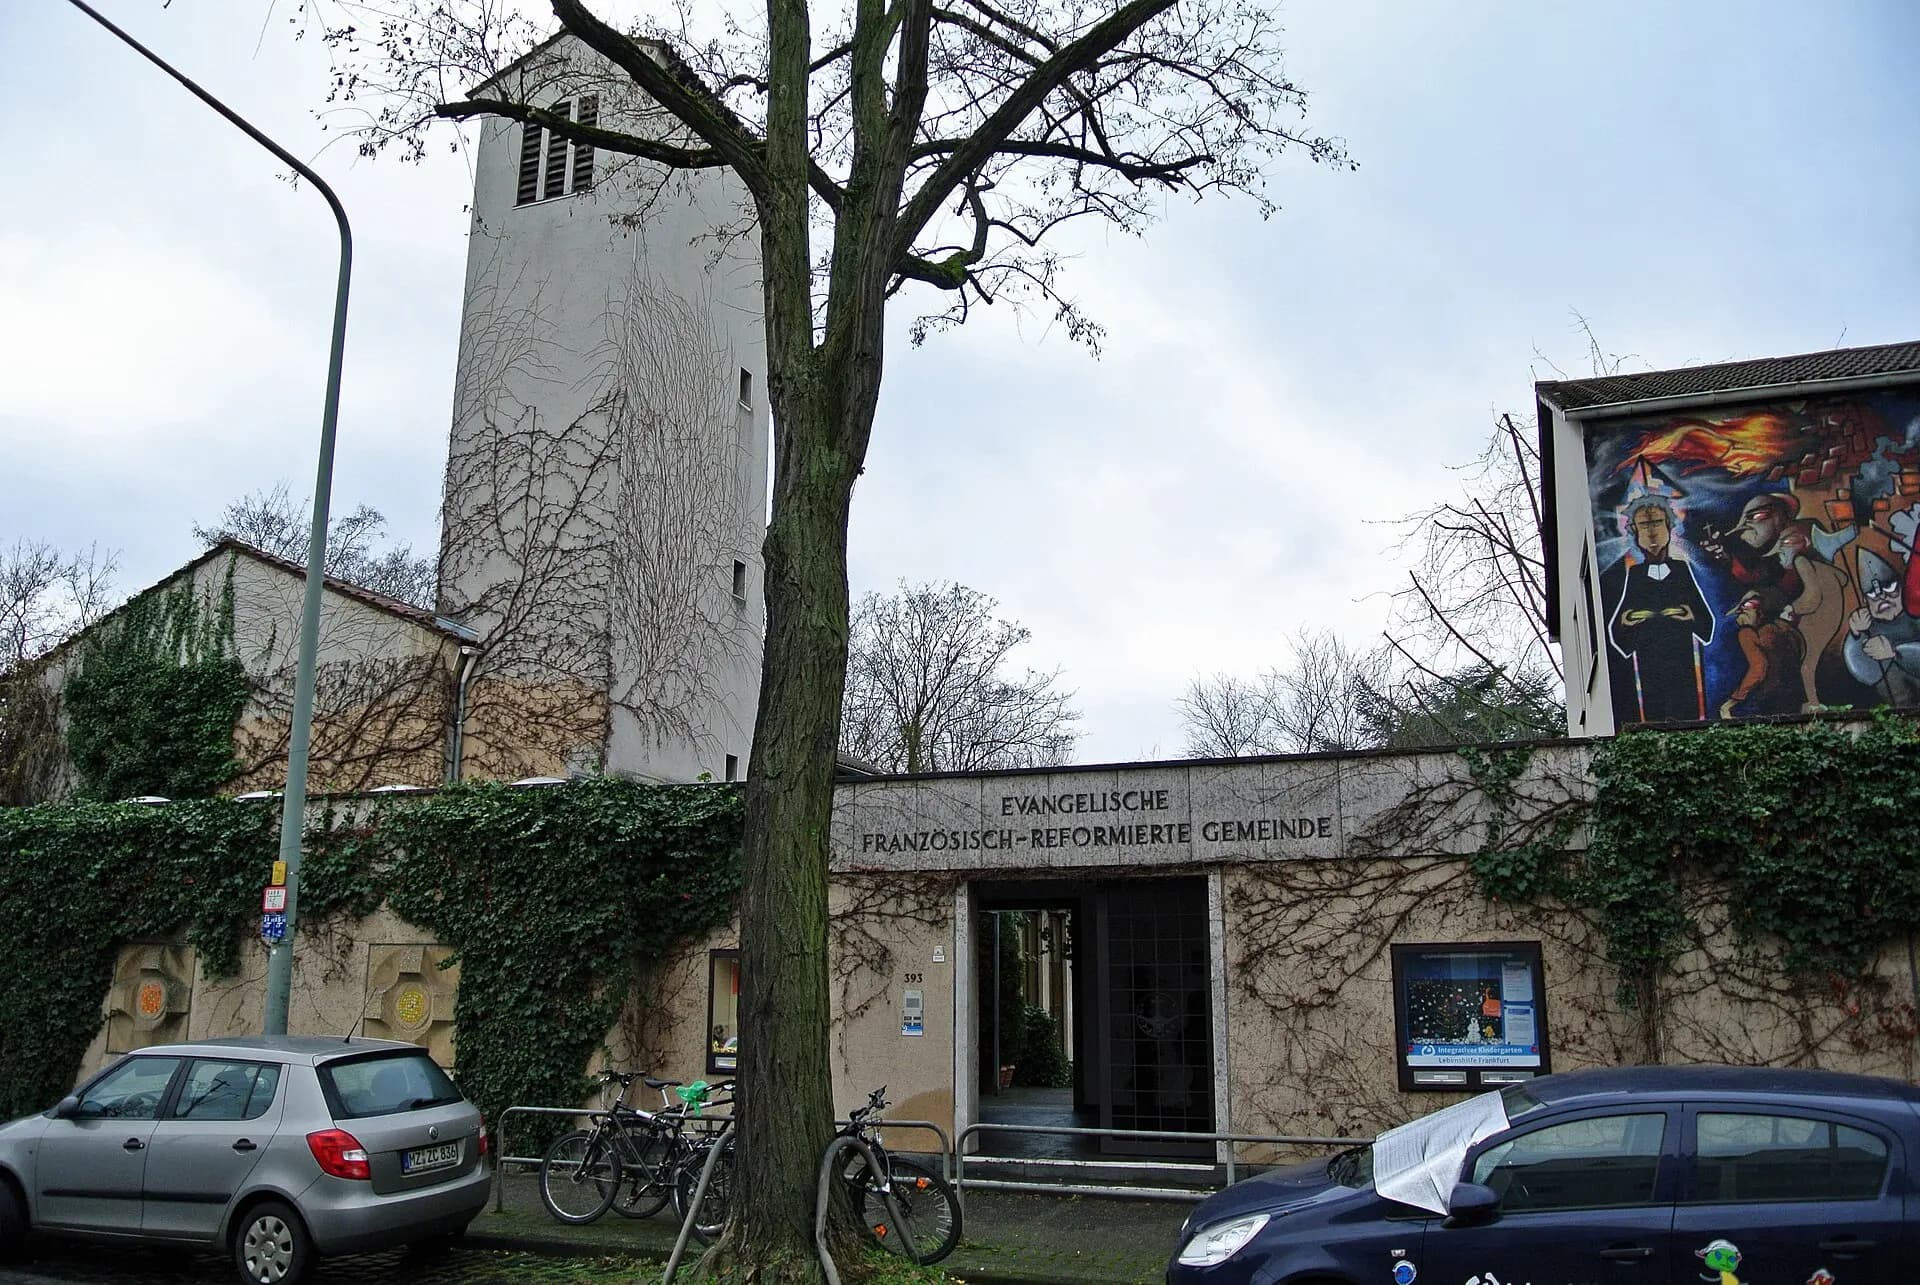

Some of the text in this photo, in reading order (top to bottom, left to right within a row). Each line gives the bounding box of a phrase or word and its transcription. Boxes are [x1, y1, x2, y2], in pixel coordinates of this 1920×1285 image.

[1001, 790, 1169, 817] EVANGELISCHE
[1202, 817, 1333, 842] GEMEINDE
[904, 973, 923, 983] 393
[1478, 1046, 1522, 1055] Kindergarten
[409, 1146, 456, 1166] MZ ZC 836
